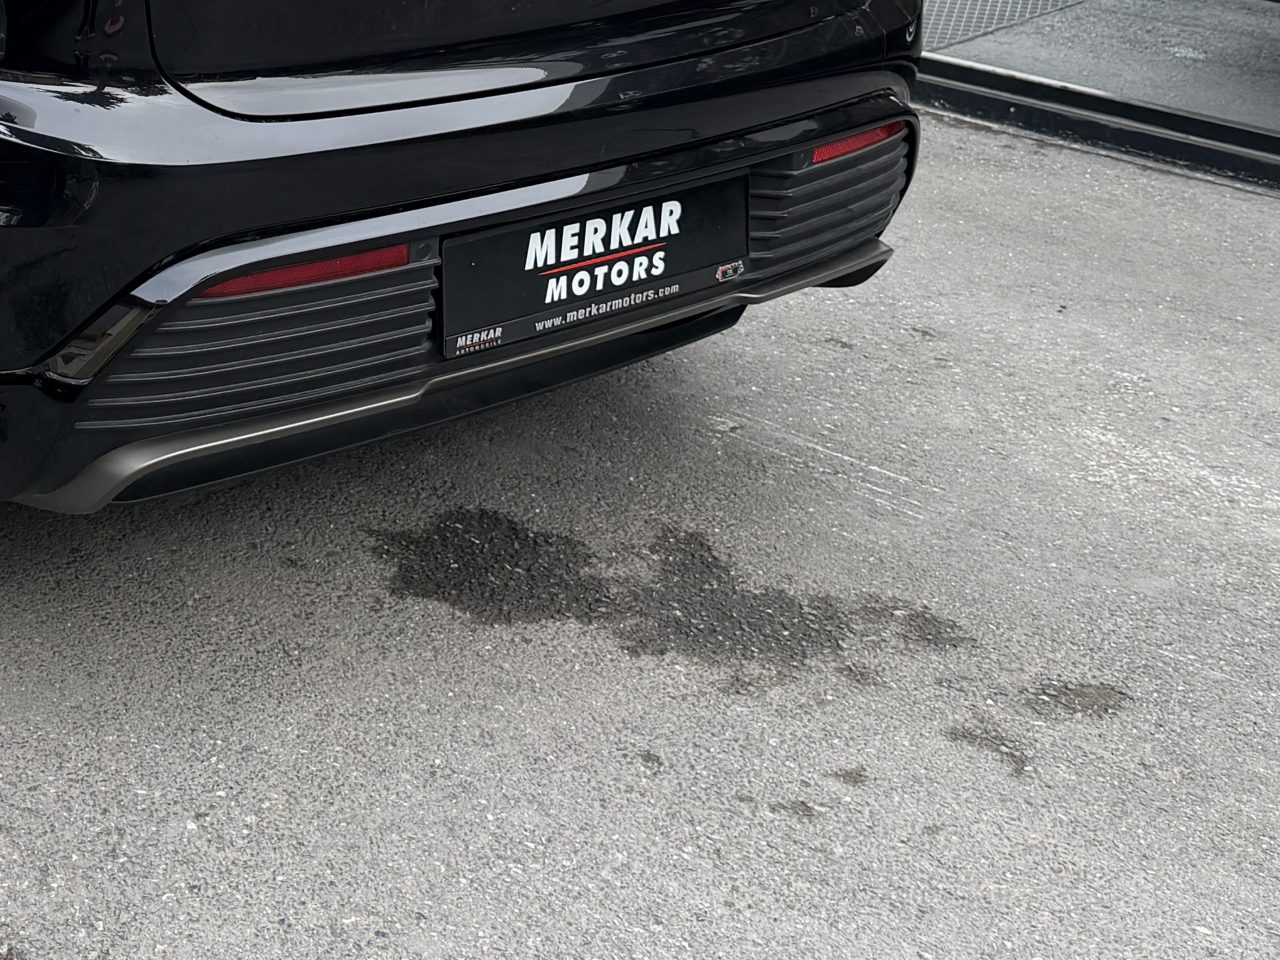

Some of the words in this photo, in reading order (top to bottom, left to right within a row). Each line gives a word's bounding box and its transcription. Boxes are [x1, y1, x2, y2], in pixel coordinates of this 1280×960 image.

[524, 200, 682, 271] MERKAR
[544, 251, 666, 304] MOTORS
[535, 283, 680, 332] www.merkarmotors.com
[456, 327, 502, 348] MERKAR
